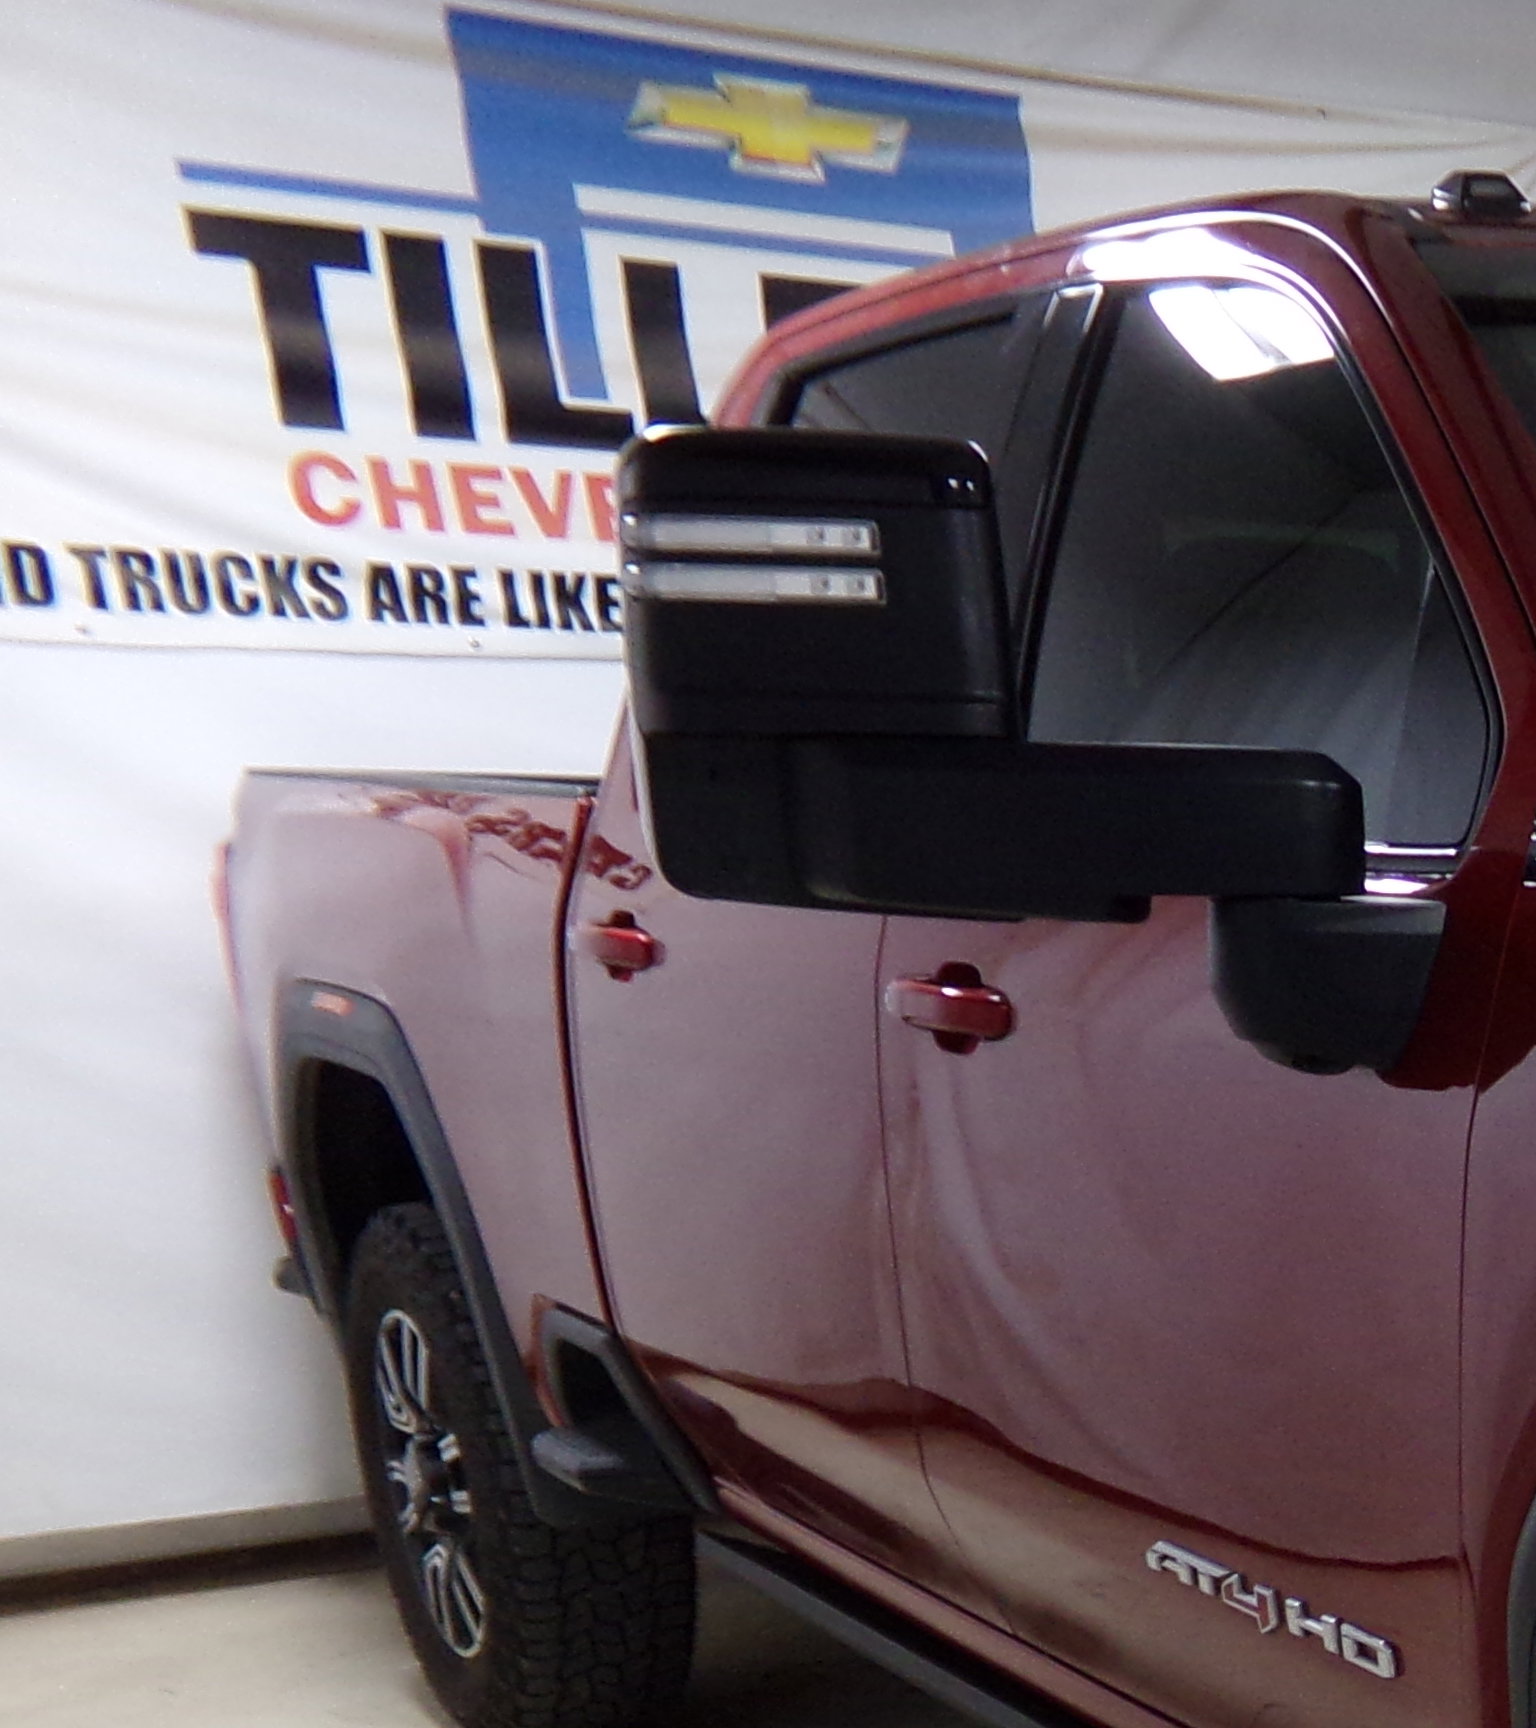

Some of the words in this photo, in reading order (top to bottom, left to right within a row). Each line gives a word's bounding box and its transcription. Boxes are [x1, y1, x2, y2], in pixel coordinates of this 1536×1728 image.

[65, 542, 350, 622] TRUCKS
[364, 559, 487, 628] ARE
[496, 567, 622, 633] LIKE
